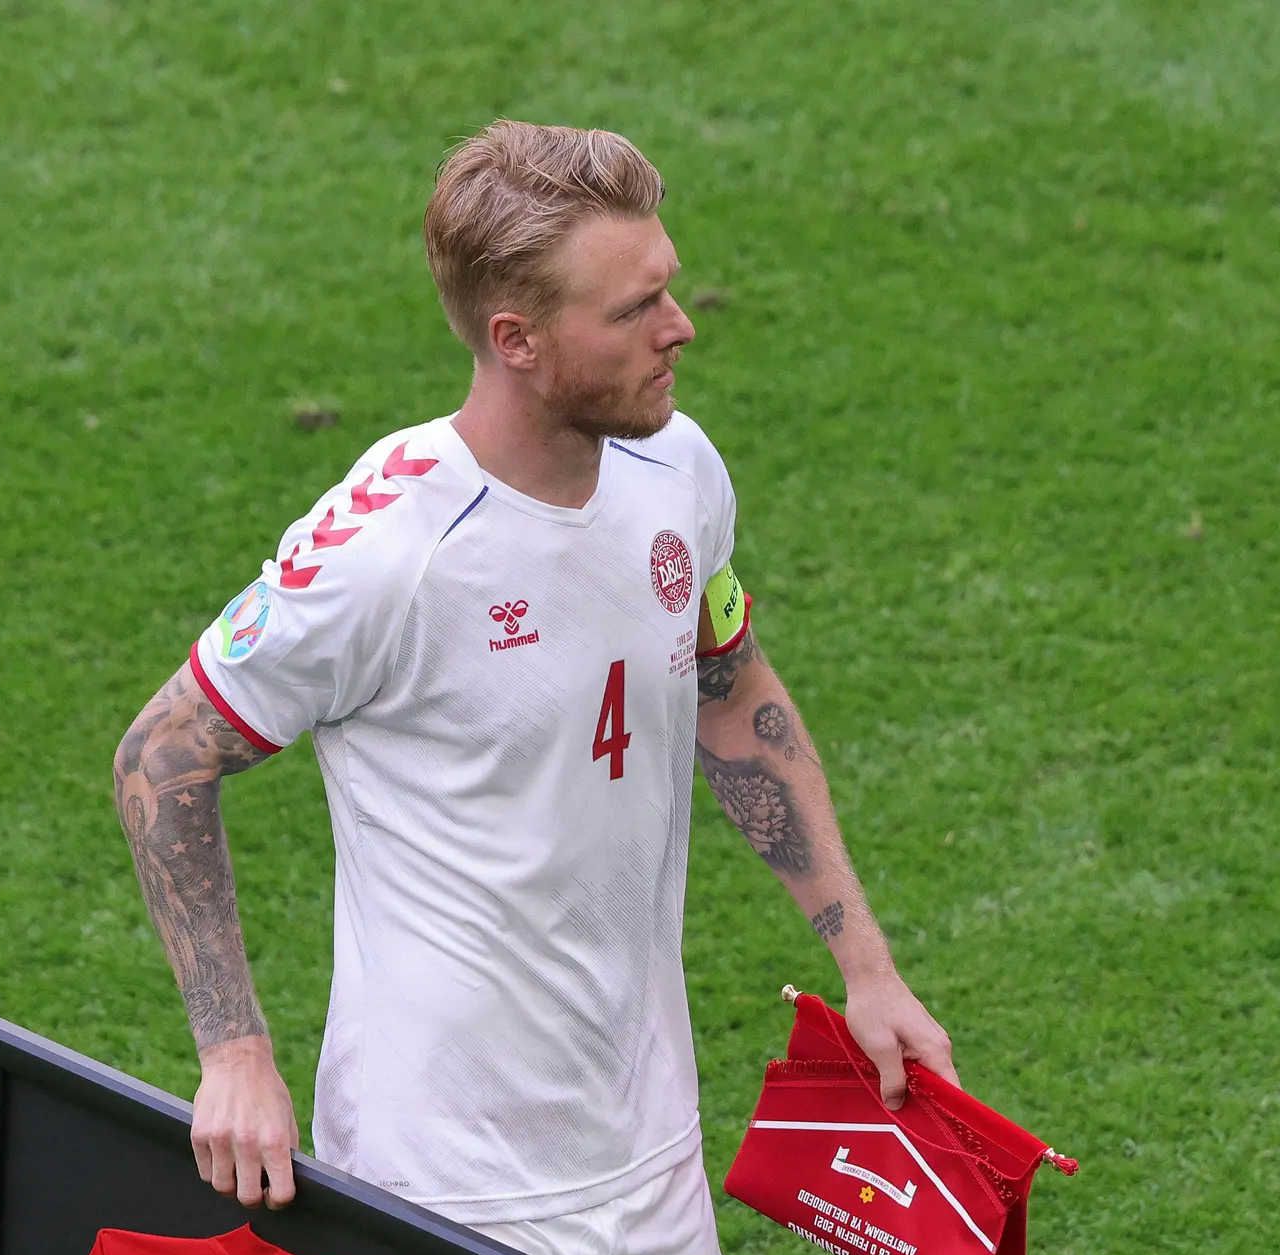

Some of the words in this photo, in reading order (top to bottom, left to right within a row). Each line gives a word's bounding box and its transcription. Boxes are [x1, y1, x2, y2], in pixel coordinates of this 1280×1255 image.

[658, 556, 684, 588] DBU
[671, 598, 687, 613] 1889
[489, 629, 540, 652] hummel
[592, 659, 632, 781] 4
[797, 1189, 851, 1225] ISELDIROEDD
[813, 1214, 835, 1234] 2021
[849, 1215, 863, 1231] YR
[834, 1225, 870, 1253] FEHEFIN
